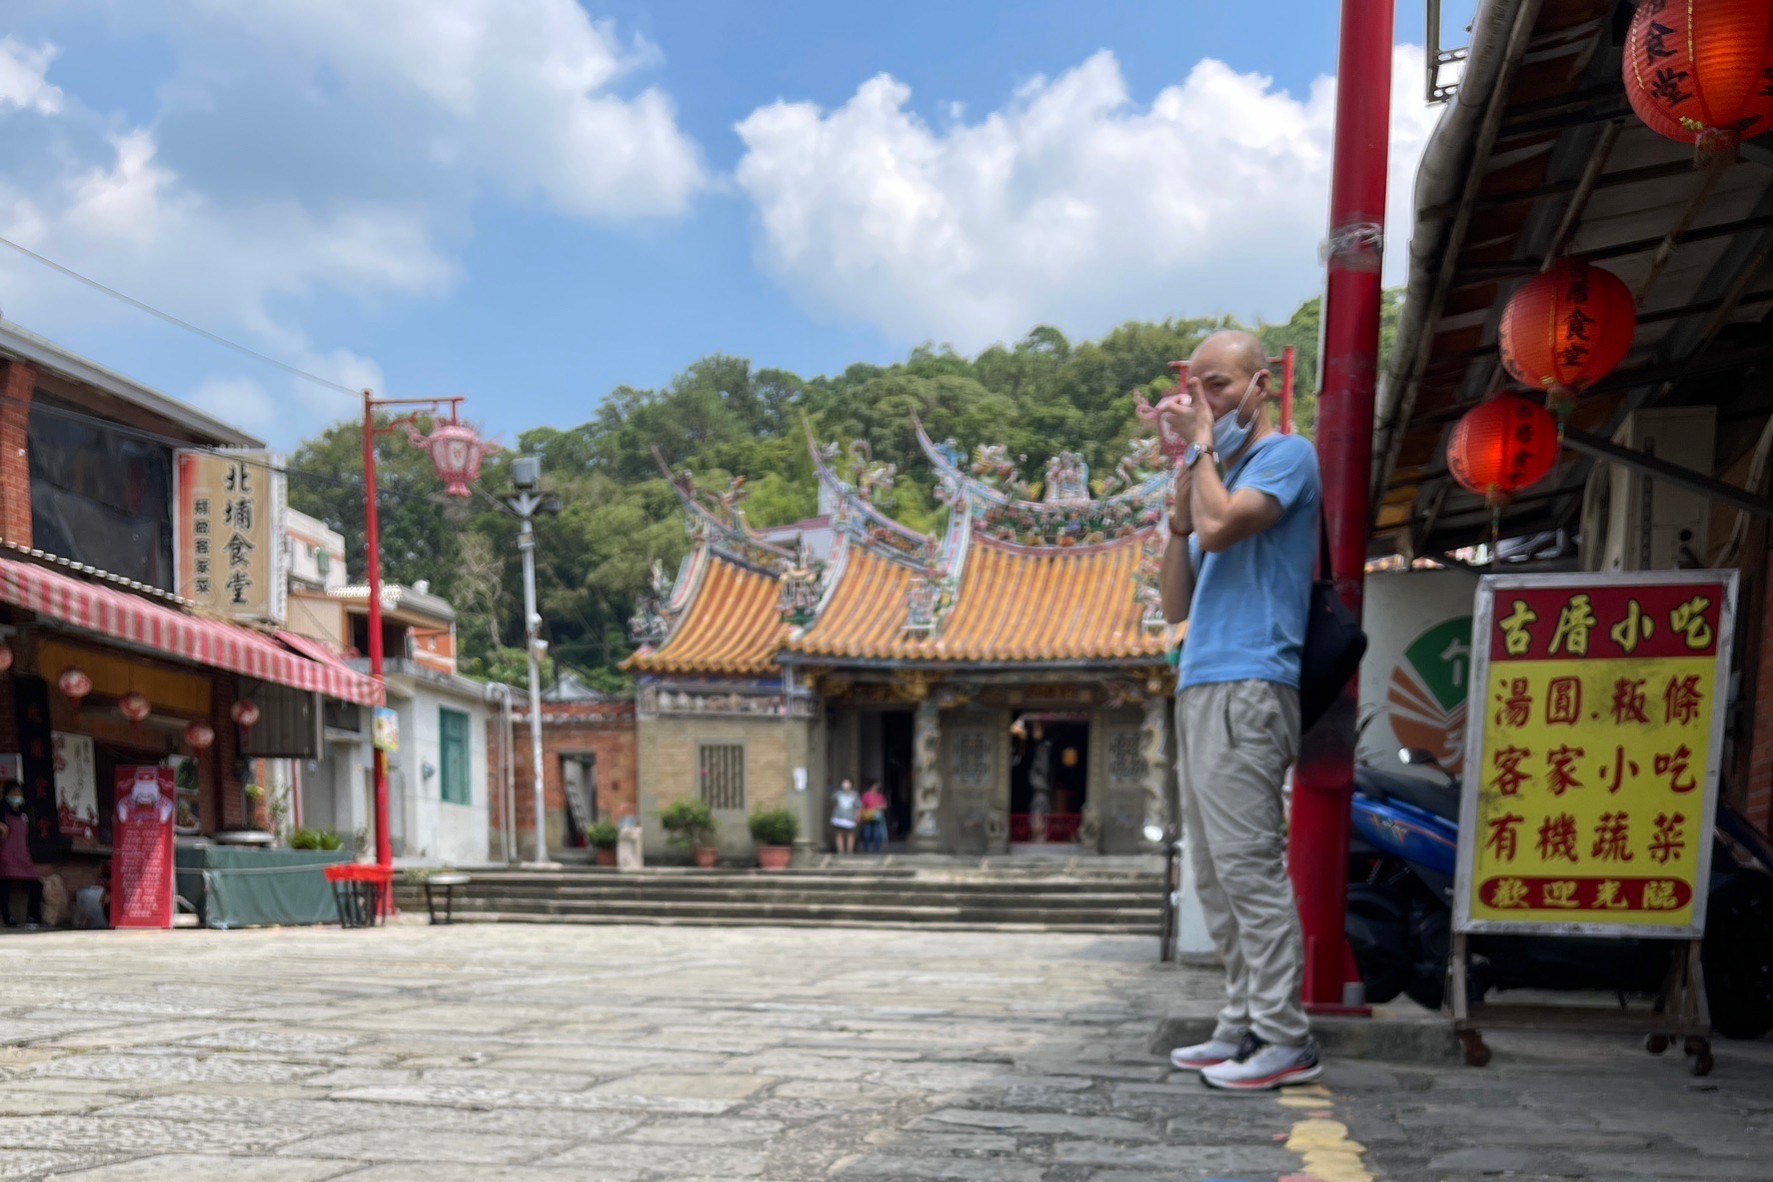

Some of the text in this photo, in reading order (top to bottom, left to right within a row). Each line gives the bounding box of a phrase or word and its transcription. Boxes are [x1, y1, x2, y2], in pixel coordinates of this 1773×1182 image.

[223, 461, 255, 605] 北埔食堂
[1500, 594, 1713, 657] 古厝小吃
[1489, 744, 1697, 796] 客家小吃
[1485, 811, 1687, 864] 有機蔬菜
[1491, 880, 1679, 910] 歡迎光臨
